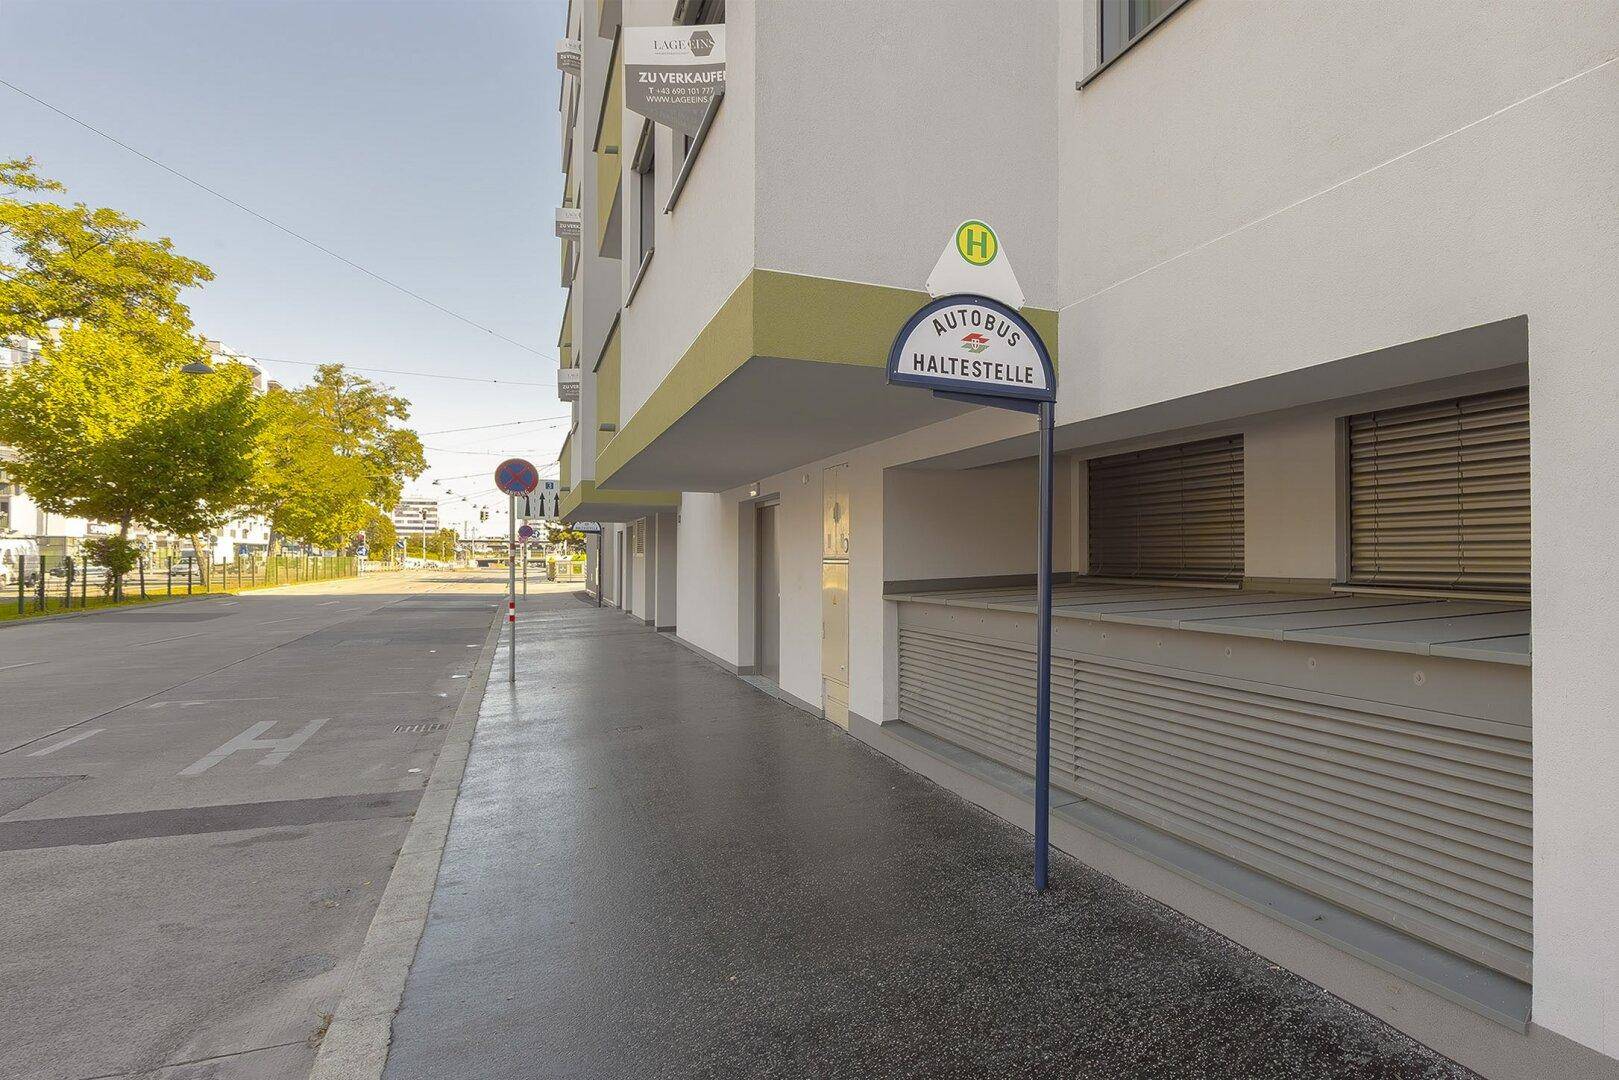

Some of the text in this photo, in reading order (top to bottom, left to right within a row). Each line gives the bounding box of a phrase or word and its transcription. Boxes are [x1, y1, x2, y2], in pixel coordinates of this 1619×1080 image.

[653, 39, 715, 50] LAGE EINS
[638, 72, 657, 83] ZU
[649, 87, 654, 95] T
[656, 87, 670, 95] +43
[672, 87, 686, 95] 690
[688, 87, 700, 95] 101
[967, 229, 987, 259] H
[931, 309, 1021, 347] AUTOBUS
[913, 353, 1034, 384] HALTESTELLE
[175, 716, 335, 776] H
